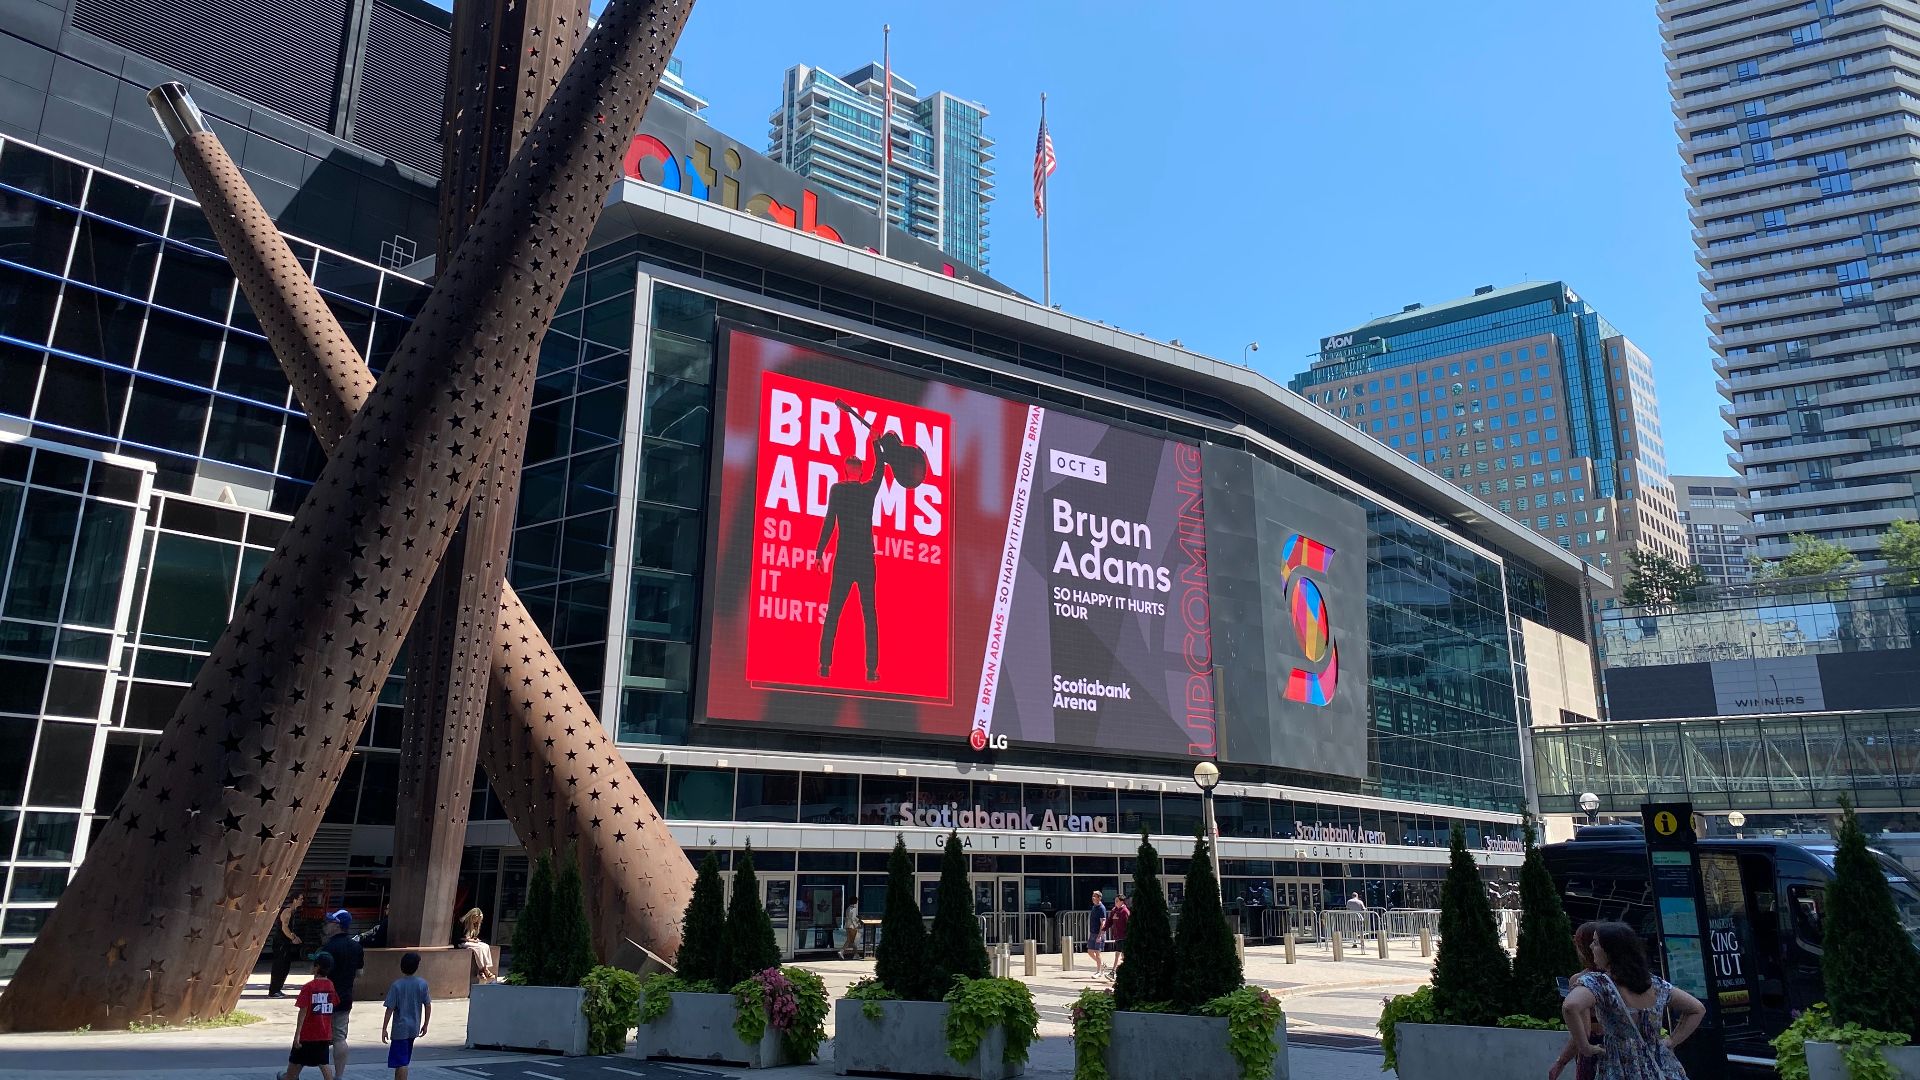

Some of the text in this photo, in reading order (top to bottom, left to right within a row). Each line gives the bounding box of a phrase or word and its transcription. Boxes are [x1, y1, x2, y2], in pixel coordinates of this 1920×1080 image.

[1057, 456, 1100, 476] OCT 5
[764, 454, 942, 537] ADMS
[763, 517, 792, 542] SO
[1053, 498, 1152, 550] Bryan
[761, 543, 833, 573] HAPPY
[873, 534, 941, 565] LIVE 22
[982, 405, 1041, 704] BRYAN ADAMS SO HAPPY IT HURTS TOUR BRYAN
[760, 569, 781, 592] IT
[1052, 540, 1171, 593] Adams
[759, 595, 829, 625] HURTS
[1053, 586, 1165, 616] SO HAPPY IT HURTS
[1053, 602, 1088, 620] TOUR
[1175, 442, 1217, 758] UPCOMING
[1053, 674, 1131, 699] Scotiabank
[1735, 696, 1805, 707] WINNERS
[1053, 692, 1097, 712] Arena
[989, 733, 1008, 749] LG
[899, 801, 1108, 833] Scotiabank Arena
[1295, 820, 1387, 845] Scotiabank Arena
